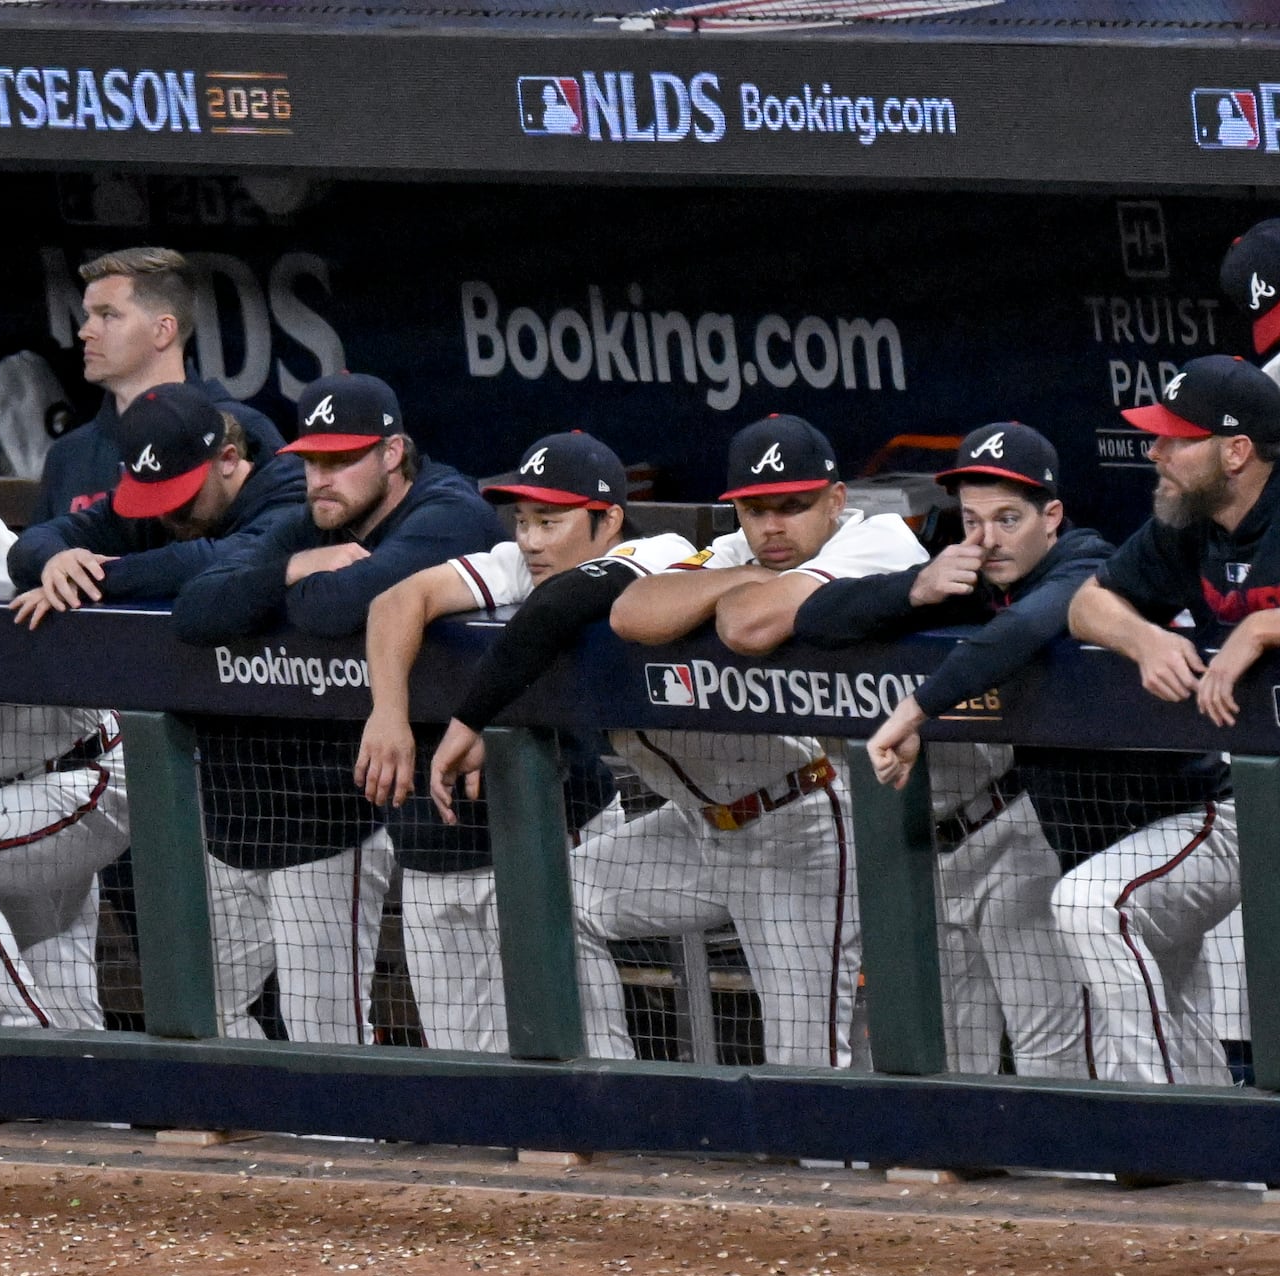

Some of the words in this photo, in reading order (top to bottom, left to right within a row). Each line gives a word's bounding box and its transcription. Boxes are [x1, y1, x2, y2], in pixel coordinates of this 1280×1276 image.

[206, 88, 293, 120] 2026
[583, 71, 727, 143] NLDS
[740, 83, 957, 145] Booking.com
[461, 281, 907, 411] Booking.com
[1085, 296, 1219, 346] TRUIST
[1098, 438, 1135, 457] HOME
